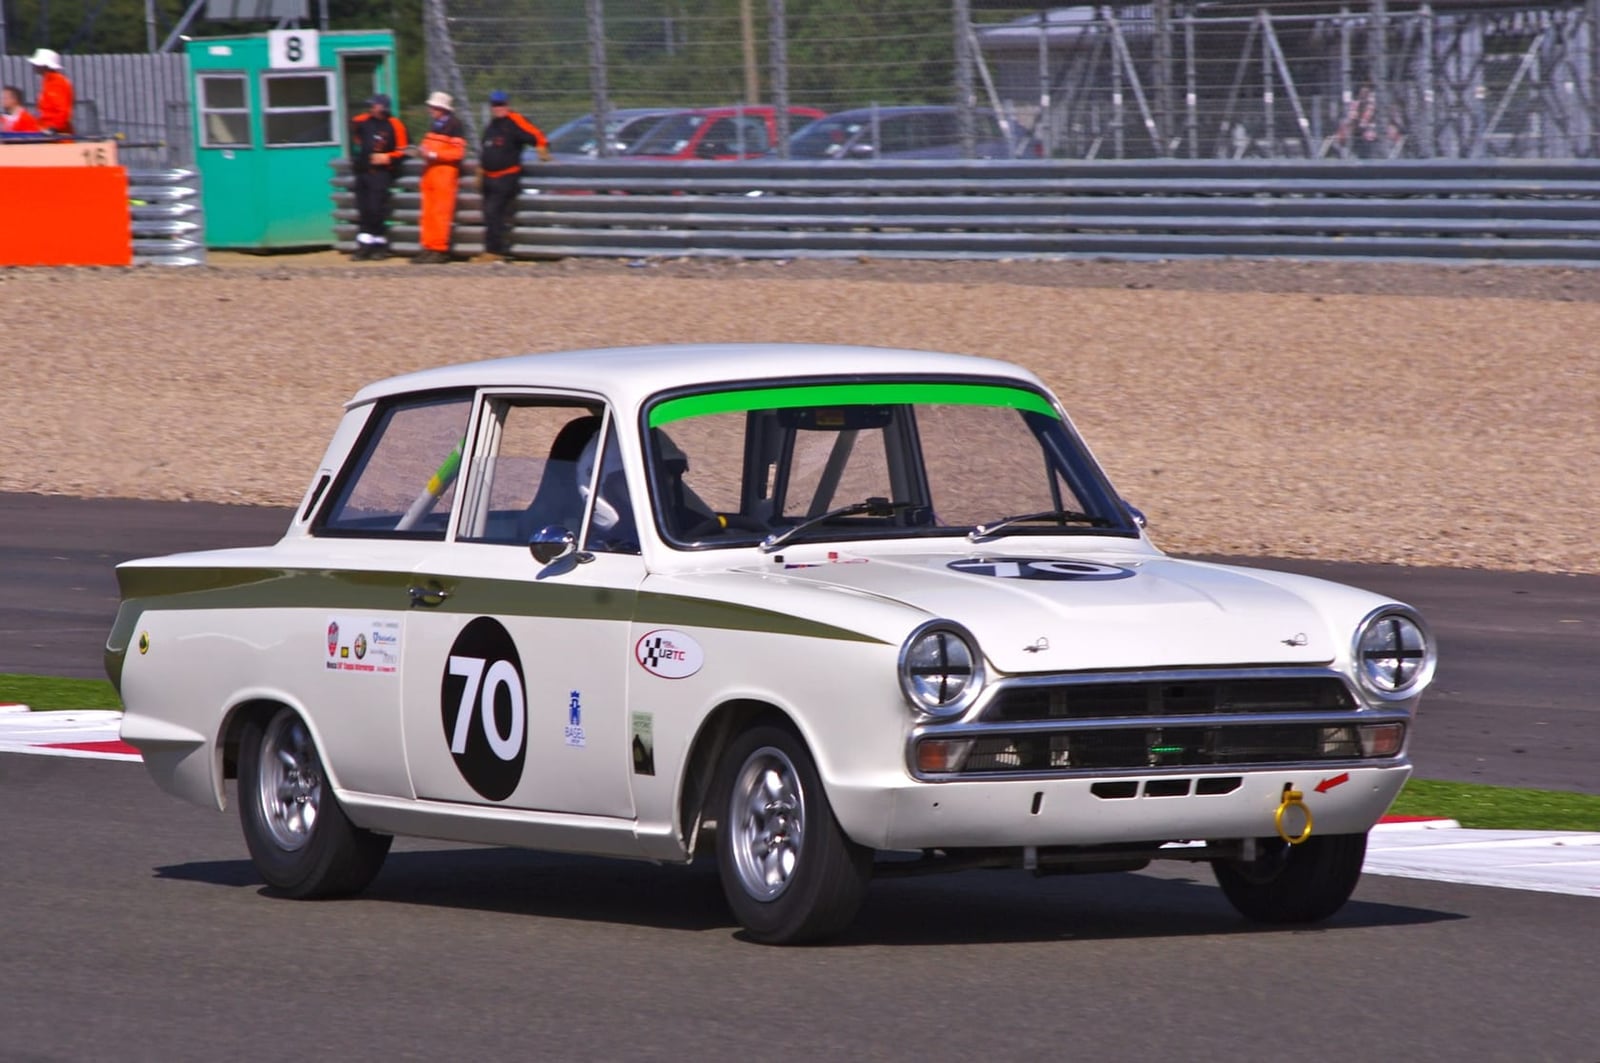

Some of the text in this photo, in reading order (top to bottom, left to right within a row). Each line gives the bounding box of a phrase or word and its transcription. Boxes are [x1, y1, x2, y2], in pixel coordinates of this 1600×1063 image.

[286, 36, 302, 62] 8
[659, 648, 686, 661] U2TC
[449, 655, 525, 761] 70
